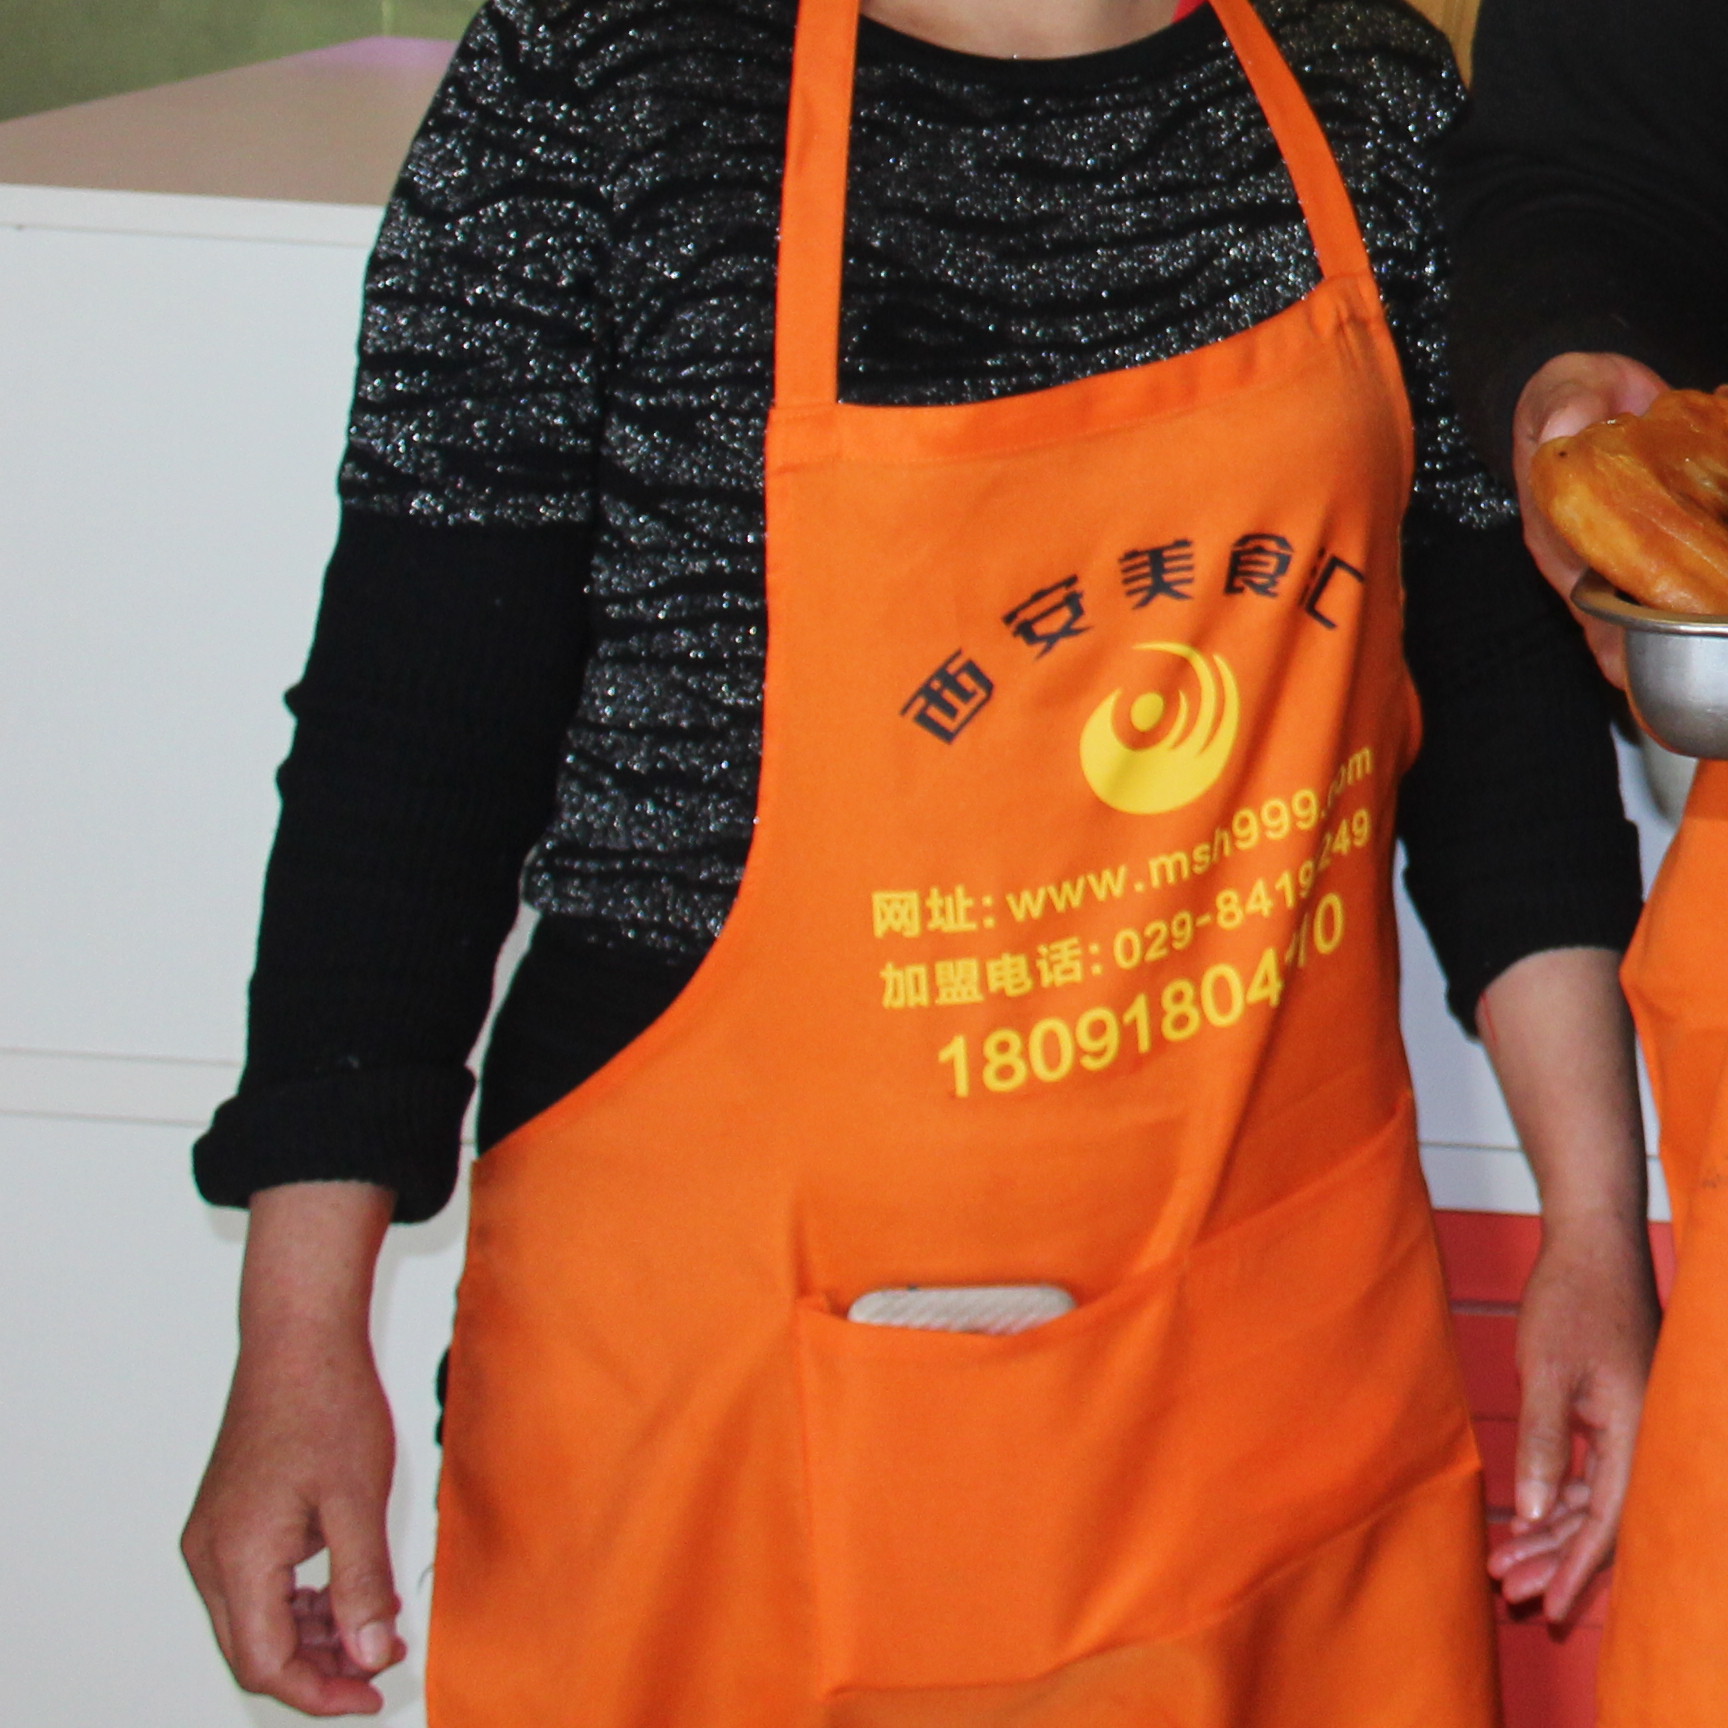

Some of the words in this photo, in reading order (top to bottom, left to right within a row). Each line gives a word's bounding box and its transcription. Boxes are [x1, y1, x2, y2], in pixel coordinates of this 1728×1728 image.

[899, 532, 1367, 745] 西安美食汇
